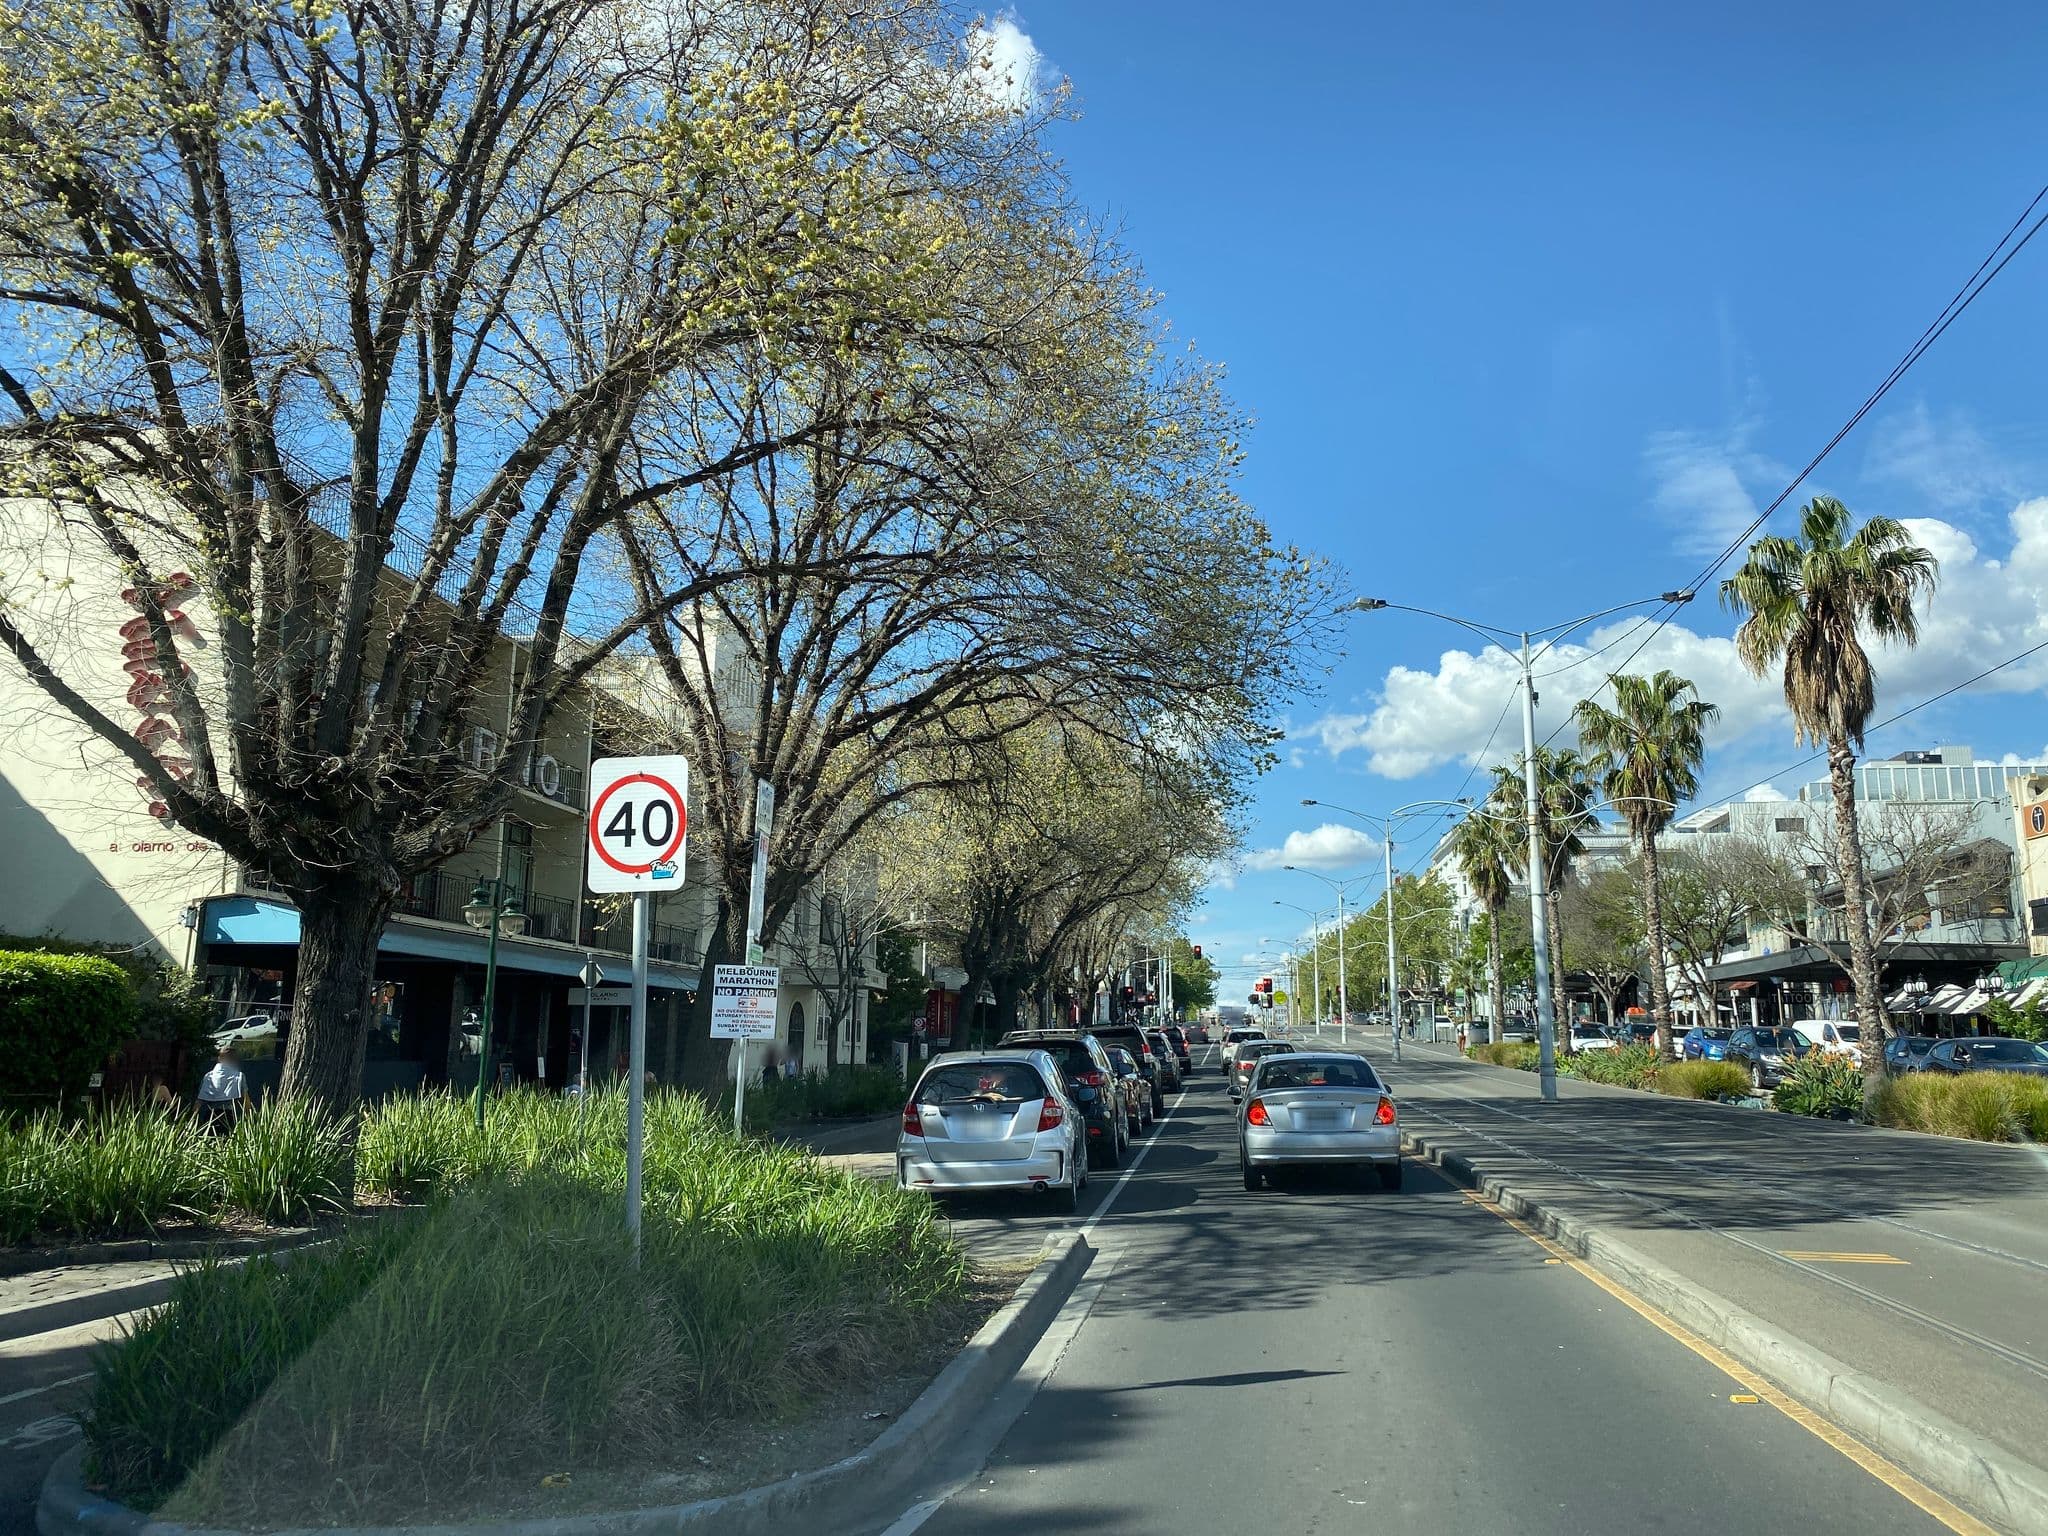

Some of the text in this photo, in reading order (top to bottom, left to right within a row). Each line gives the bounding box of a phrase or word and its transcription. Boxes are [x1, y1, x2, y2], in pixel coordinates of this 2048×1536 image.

[603, 799, 674, 848] 40
[717, 967, 777, 978] MELBOURNE
[719, 977, 775, 985] MARATHON
[717, 988, 775, 997] NO PARKING
[1771, 993, 1812, 1003] TTTOO
